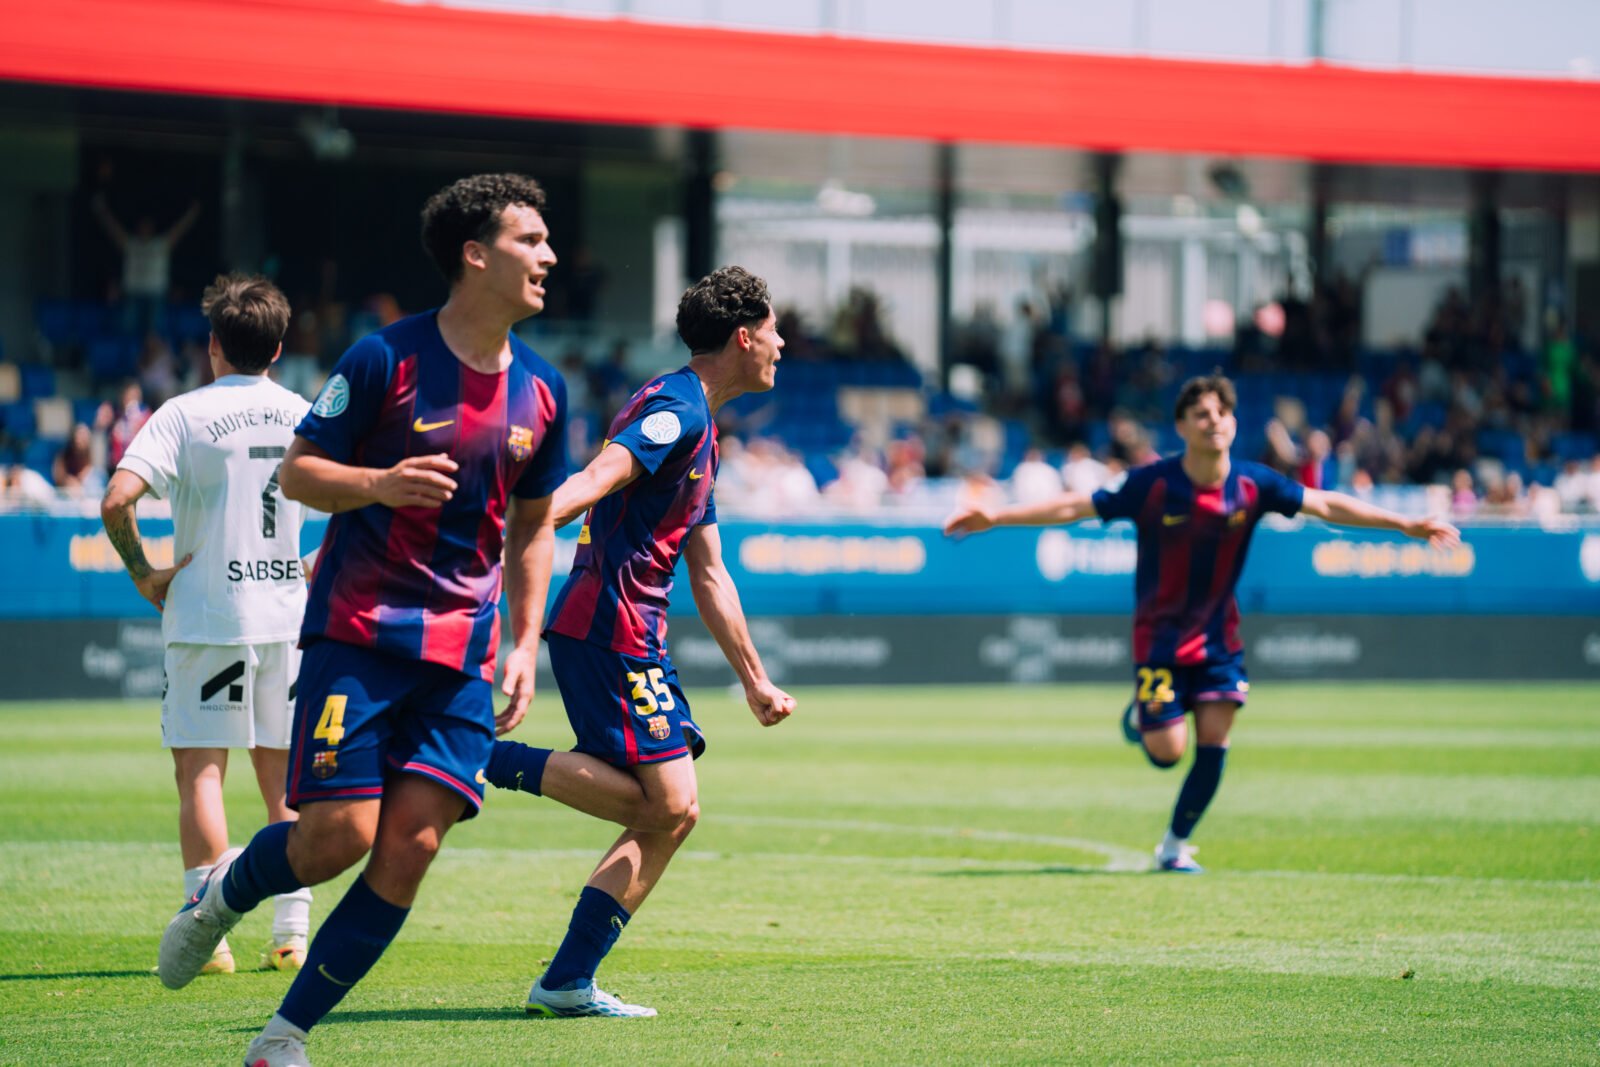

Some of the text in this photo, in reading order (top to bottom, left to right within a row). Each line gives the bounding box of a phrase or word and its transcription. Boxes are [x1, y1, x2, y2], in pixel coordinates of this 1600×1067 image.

[206, 407, 304, 443] JAUME PASC
[248, 446, 287, 538] 7
[627, 667, 675, 715] 35
[1138, 667, 1175, 702] 22
[313, 694, 348, 745] 4
